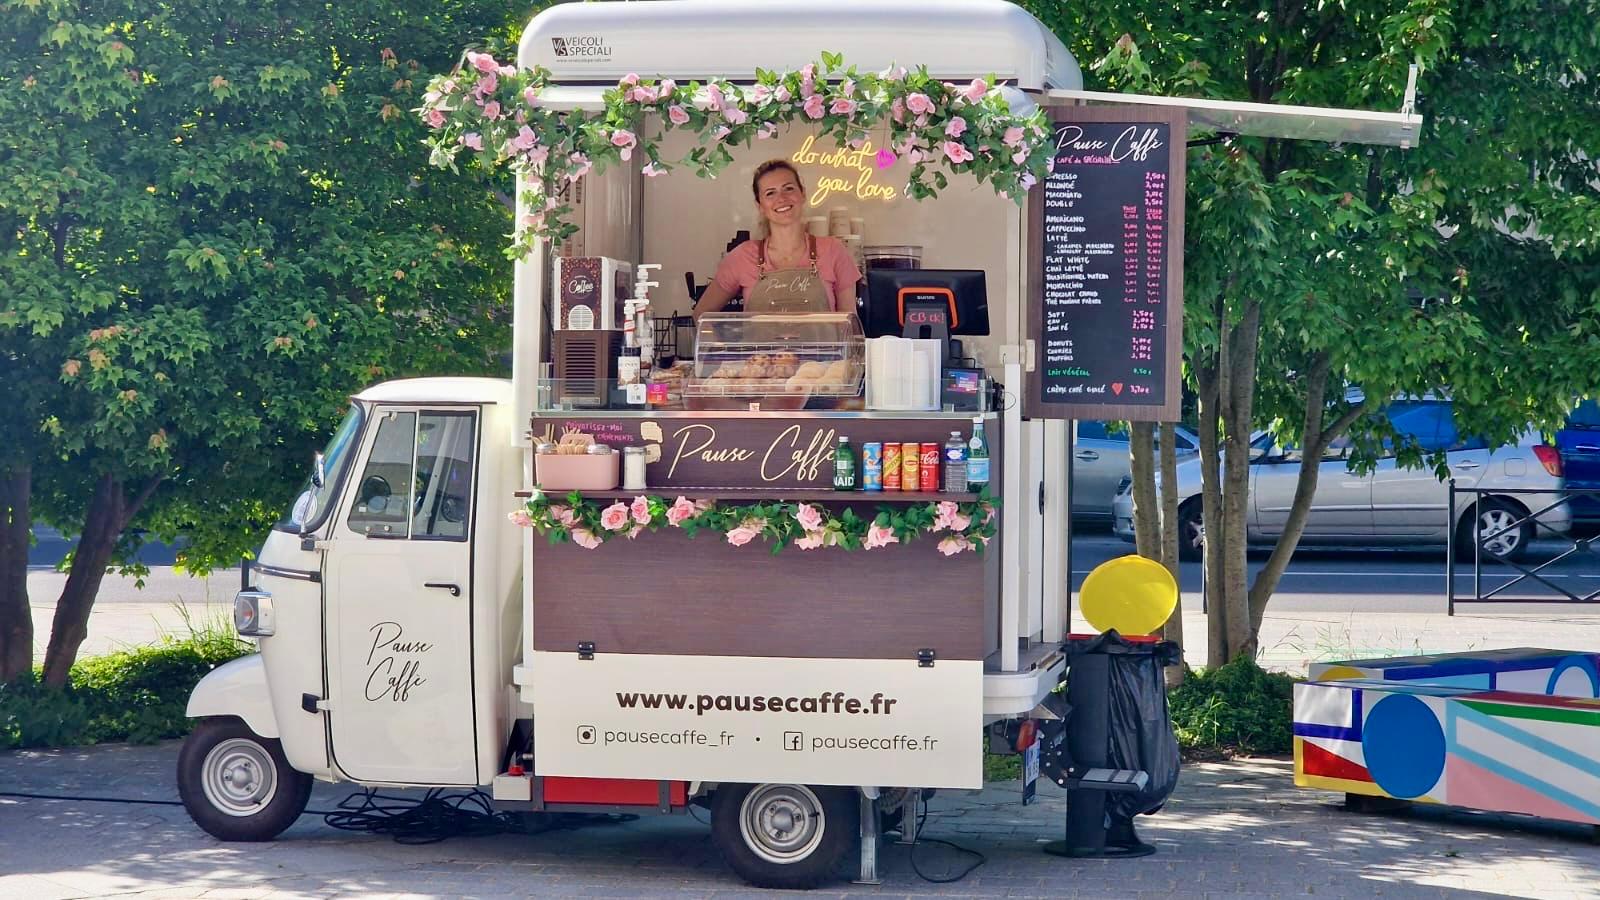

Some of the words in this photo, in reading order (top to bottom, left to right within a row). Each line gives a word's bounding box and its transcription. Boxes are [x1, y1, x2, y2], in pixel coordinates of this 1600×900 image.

[566, 36, 604, 46] VEICOLI
[569, 46, 612, 56] SPECIALI
[792, 136, 819, 164] do
[820, 141, 878, 171] what
[1056, 126, 1108, 150] Pause
[1111, 126, 1162, 162] Caffè
[810, 176, 853, 206] you
[856, 168, 897, 200] love
[569, 280, 594, 294] Coffee
[668, 424, 754, 479] Pause
[760, 424, 835, 481] Caffè
[366, 622, 433, 665] Pause
[365, 656, 426, 702] Caffè
[616, 692, 897, 716] www.pausecaffe.fr
[604, 730, 734, 746] pausecaffe_fr
[812, 734, 938, 752] pausecaffe.fr
